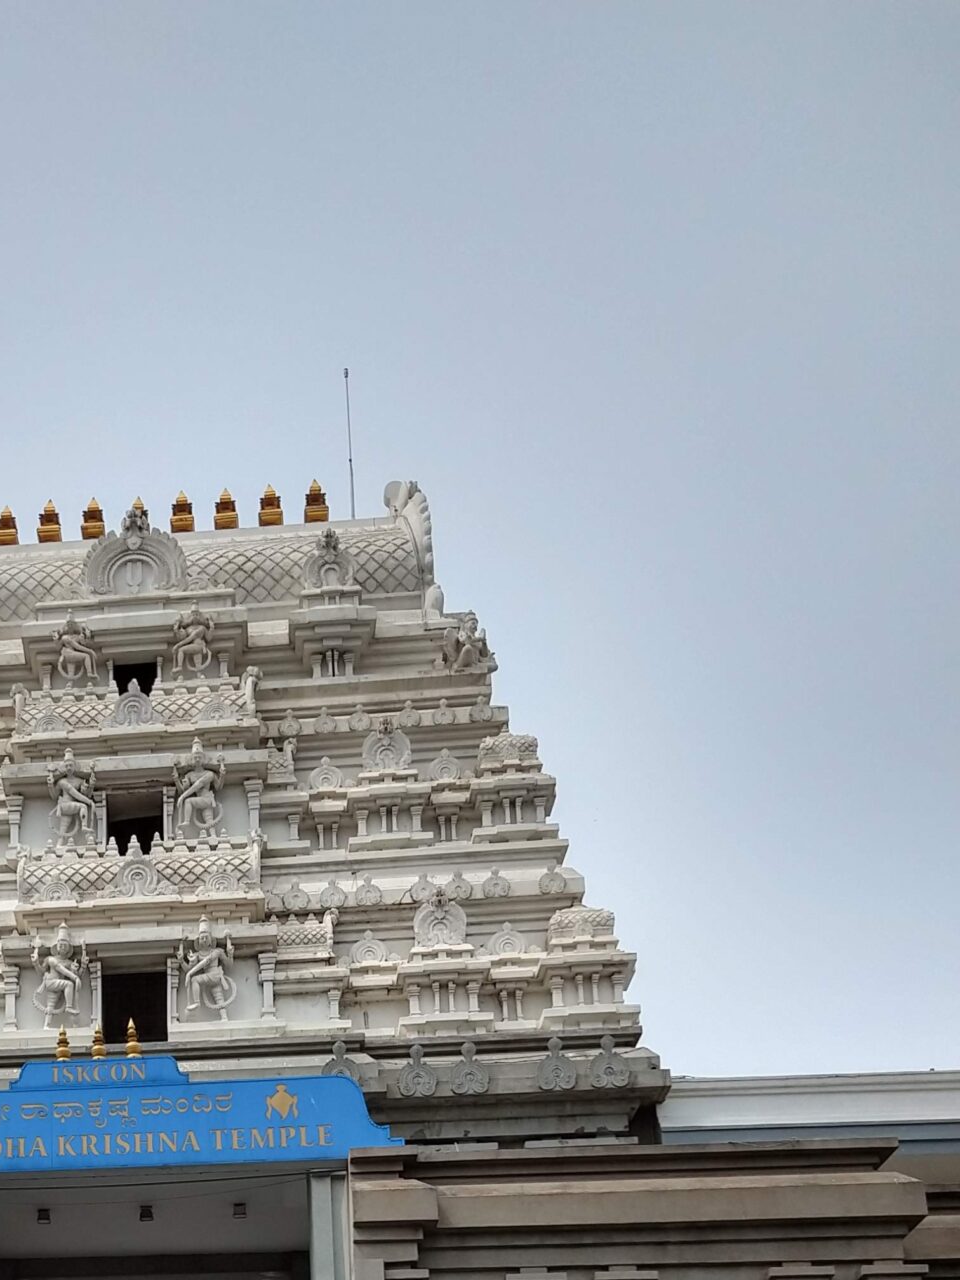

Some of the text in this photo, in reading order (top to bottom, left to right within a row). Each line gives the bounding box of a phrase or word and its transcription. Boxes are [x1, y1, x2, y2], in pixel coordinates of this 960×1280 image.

[52, 1063, 146, 1084] ISKCON
[57, 1129, 201, 1157] KRISHNA
[210, 1124, 335, 1151] TEMPLE
